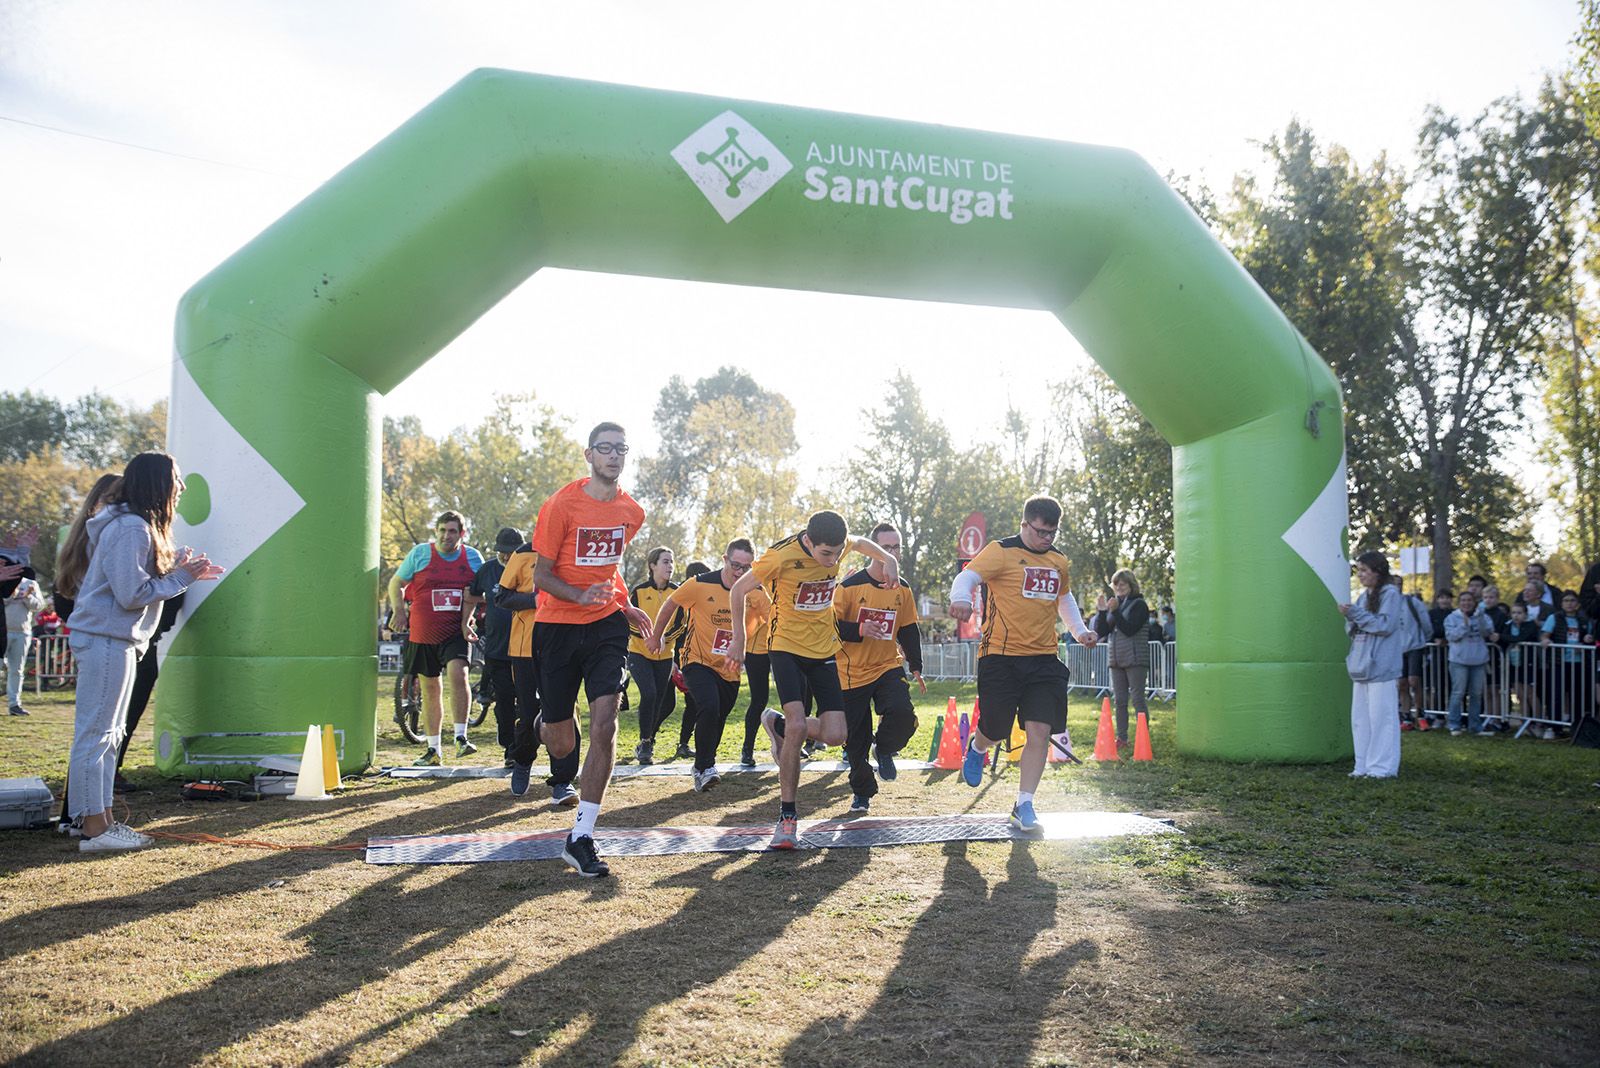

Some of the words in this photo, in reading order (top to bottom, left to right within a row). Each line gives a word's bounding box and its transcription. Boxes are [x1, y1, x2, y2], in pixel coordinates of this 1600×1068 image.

[806, 141, 976, 179] AJUNTAMENT
[982, 161, 1014, 184] DE
[803, 166, 1014, 224] SantCugat
[586, 541, 616, 557] 221
[1031, 578, 1055, 593] 216
[445, 597, 451, 606] 1
[804, 590, 831, 604] 212
